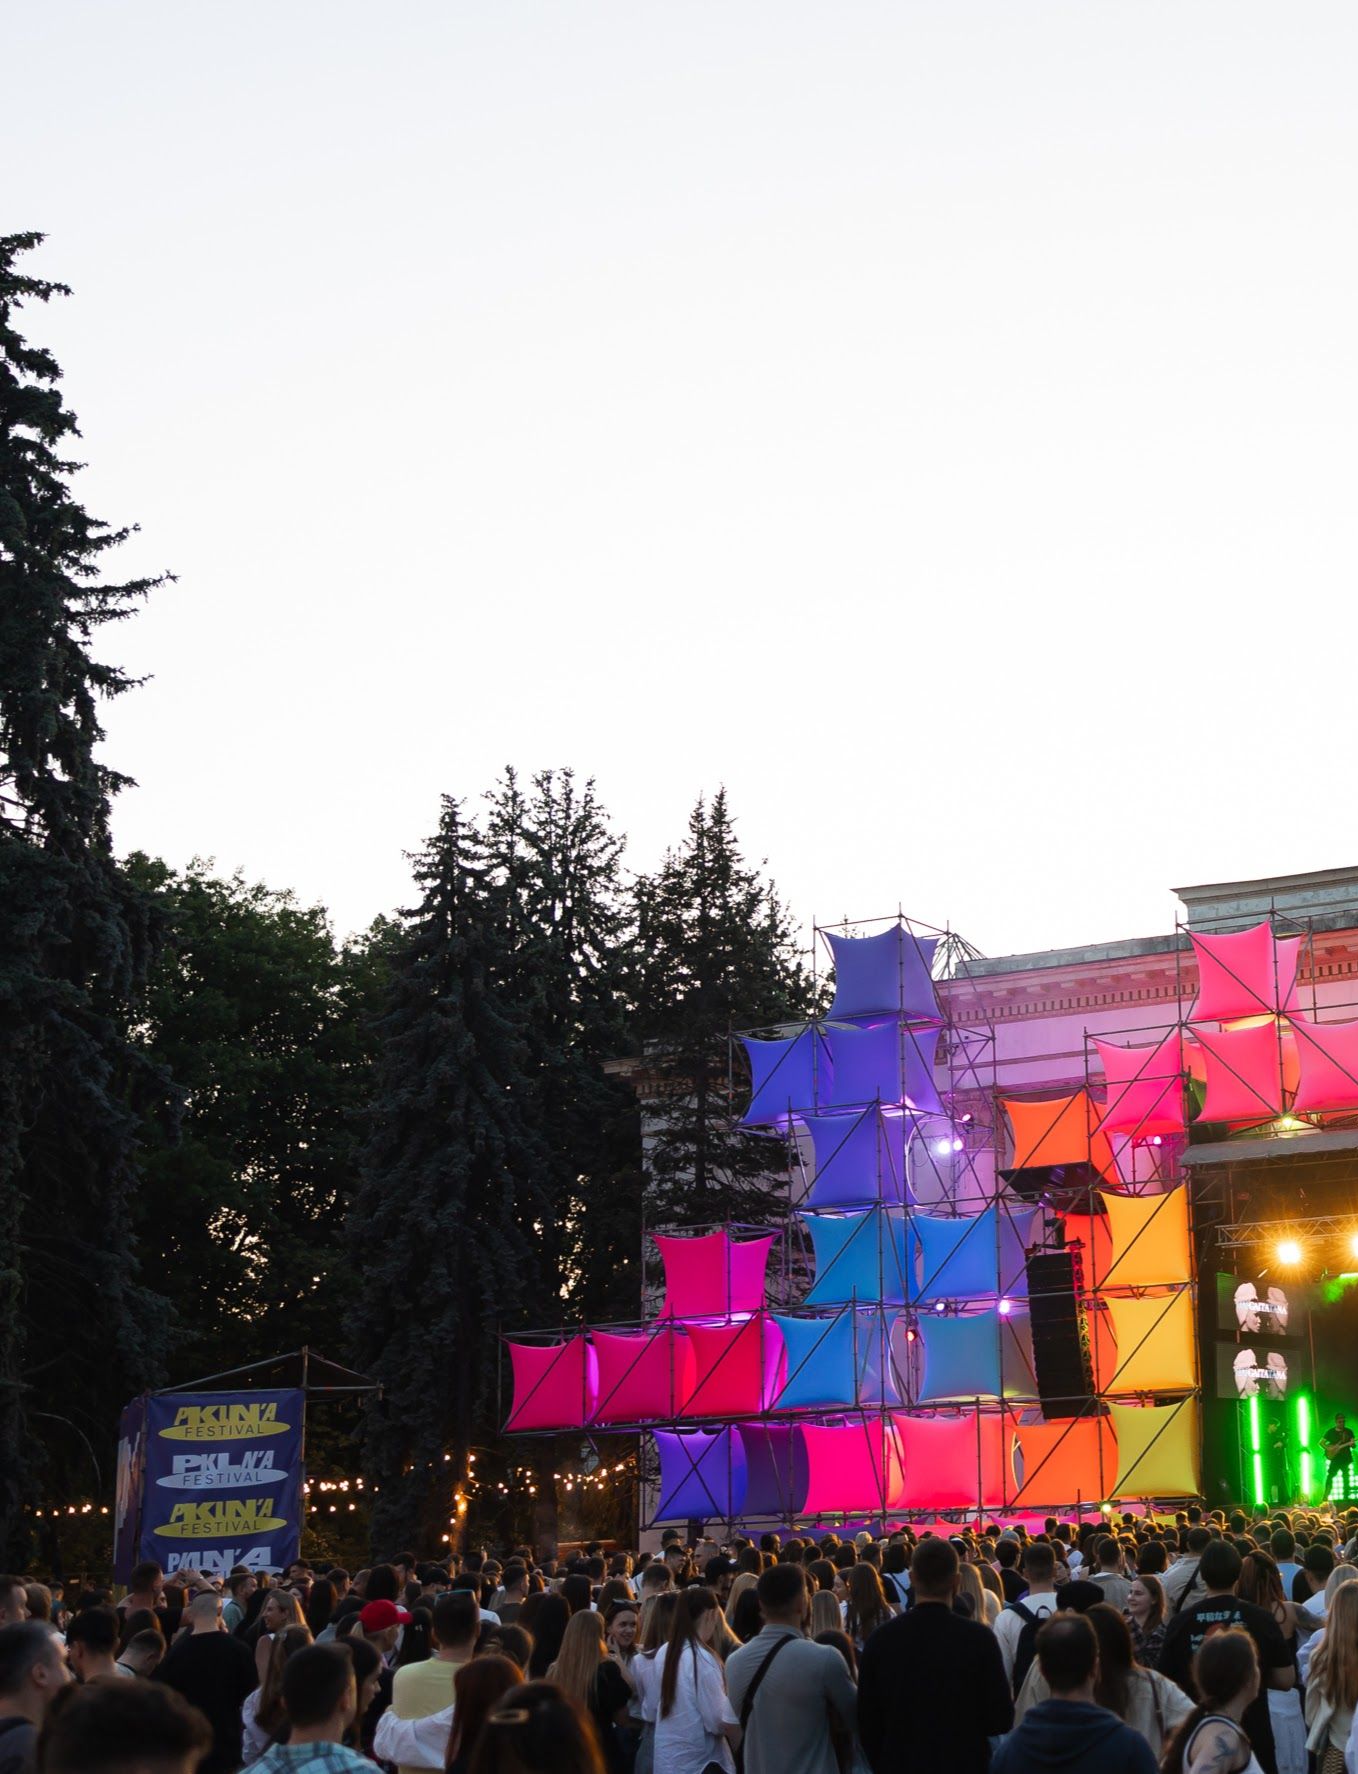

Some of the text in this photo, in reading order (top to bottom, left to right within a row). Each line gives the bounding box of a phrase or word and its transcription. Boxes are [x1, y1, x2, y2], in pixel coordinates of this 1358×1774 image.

[184, 1424, 265, 1438] FESTIVAL
[183, 1472, 262, 1486] FESTIVAL
[180, 1520, 261, 1535] FESTIVAL
